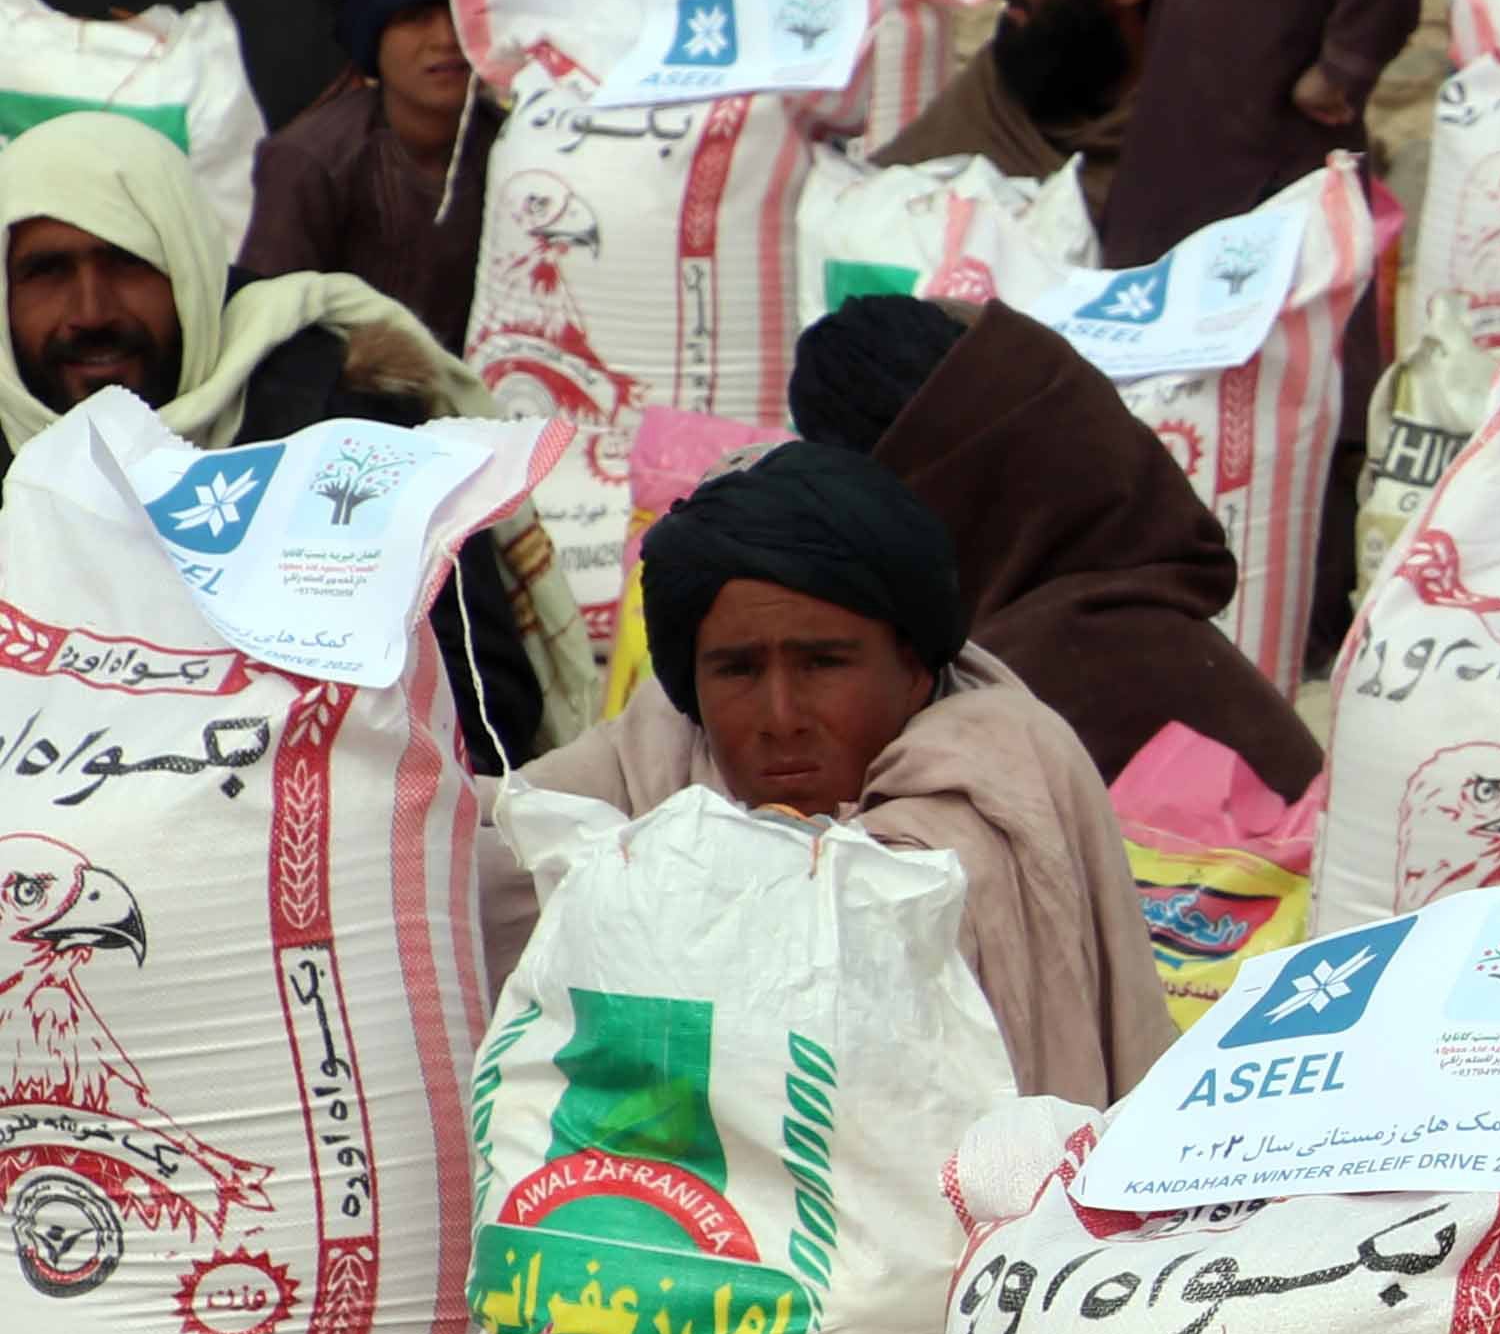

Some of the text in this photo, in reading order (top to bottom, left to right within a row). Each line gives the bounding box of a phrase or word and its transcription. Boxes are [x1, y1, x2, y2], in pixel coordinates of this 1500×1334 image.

[109, 648, 210, 686] بکواه
[322, 658, 366, 672] 2022
[16, 716, 271, 806] بکواه
[1177, 1051, 1345, 1111] ASEEL
[1296, 1124, 1396, 1160] زمستانی
[1400, 1113, 1448, 1144] های
[1241, 1133, 1292, 1163] سال
[1123, 1170, 1246, 1197] KANDAHAR
[1251, 1163, 1333, 1187] WINTER
[1336, 1152, 1413, 1179] RELEIF
[1416, 1152, 1488, 1174] DRIVE
[515, 1157, 736, 1253] AWAL ZAFRANI TEA
